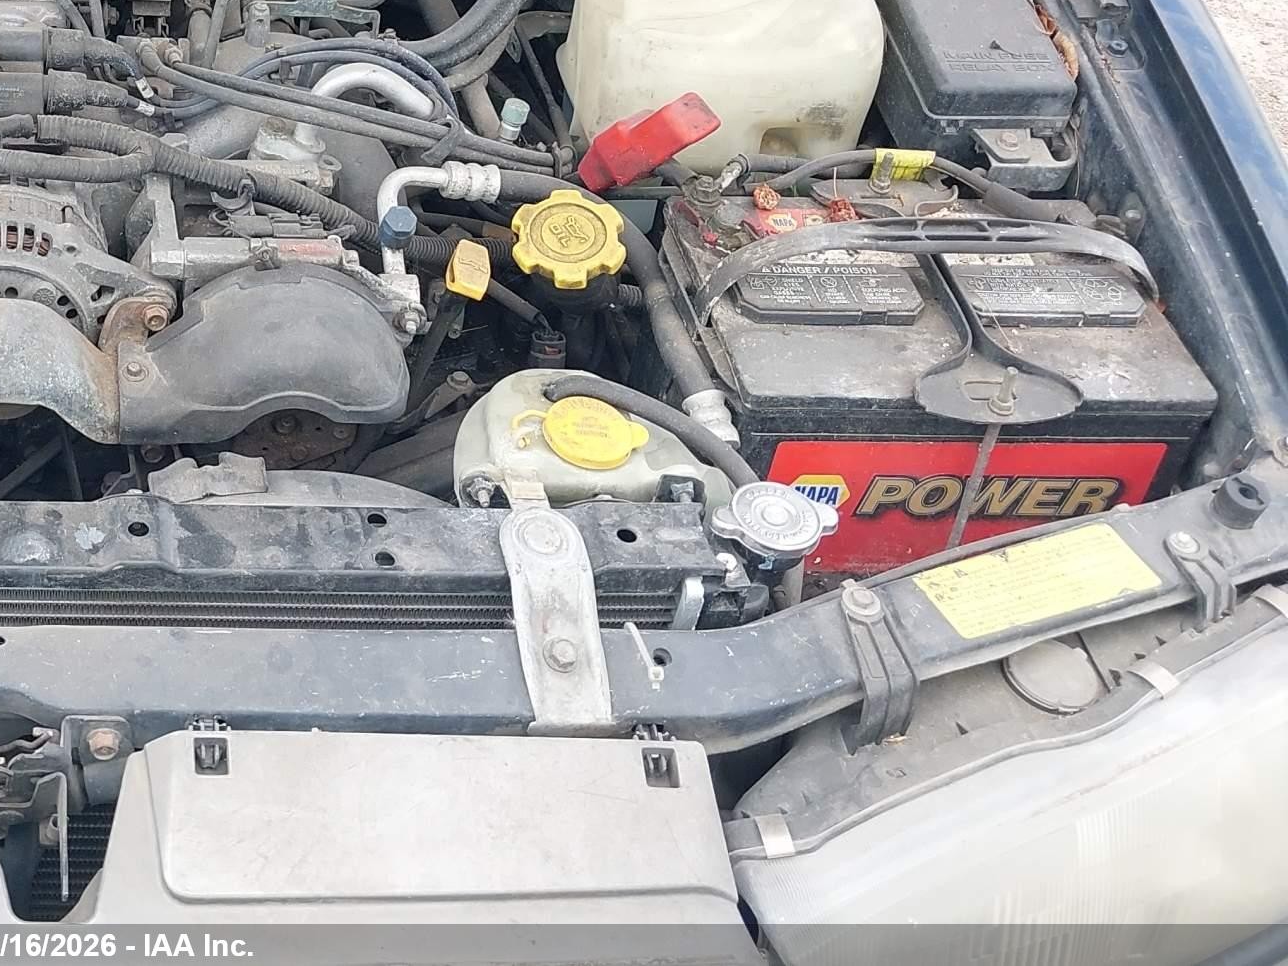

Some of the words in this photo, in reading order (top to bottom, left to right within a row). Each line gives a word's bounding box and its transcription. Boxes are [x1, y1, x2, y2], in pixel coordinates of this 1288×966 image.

[943, 50, 996, 60] MAIN
[948, 63, 1006, 73] RELAY
[1015, 63, 1055, 73] BOX
[773, 217, 794, 227] NAPA
[550, 223, 570, 248] OIL
[772, 265, 821, 274] DANGER
[833, 266, 877, 275] POISON
[853, 474, 1120, 516] POWER
